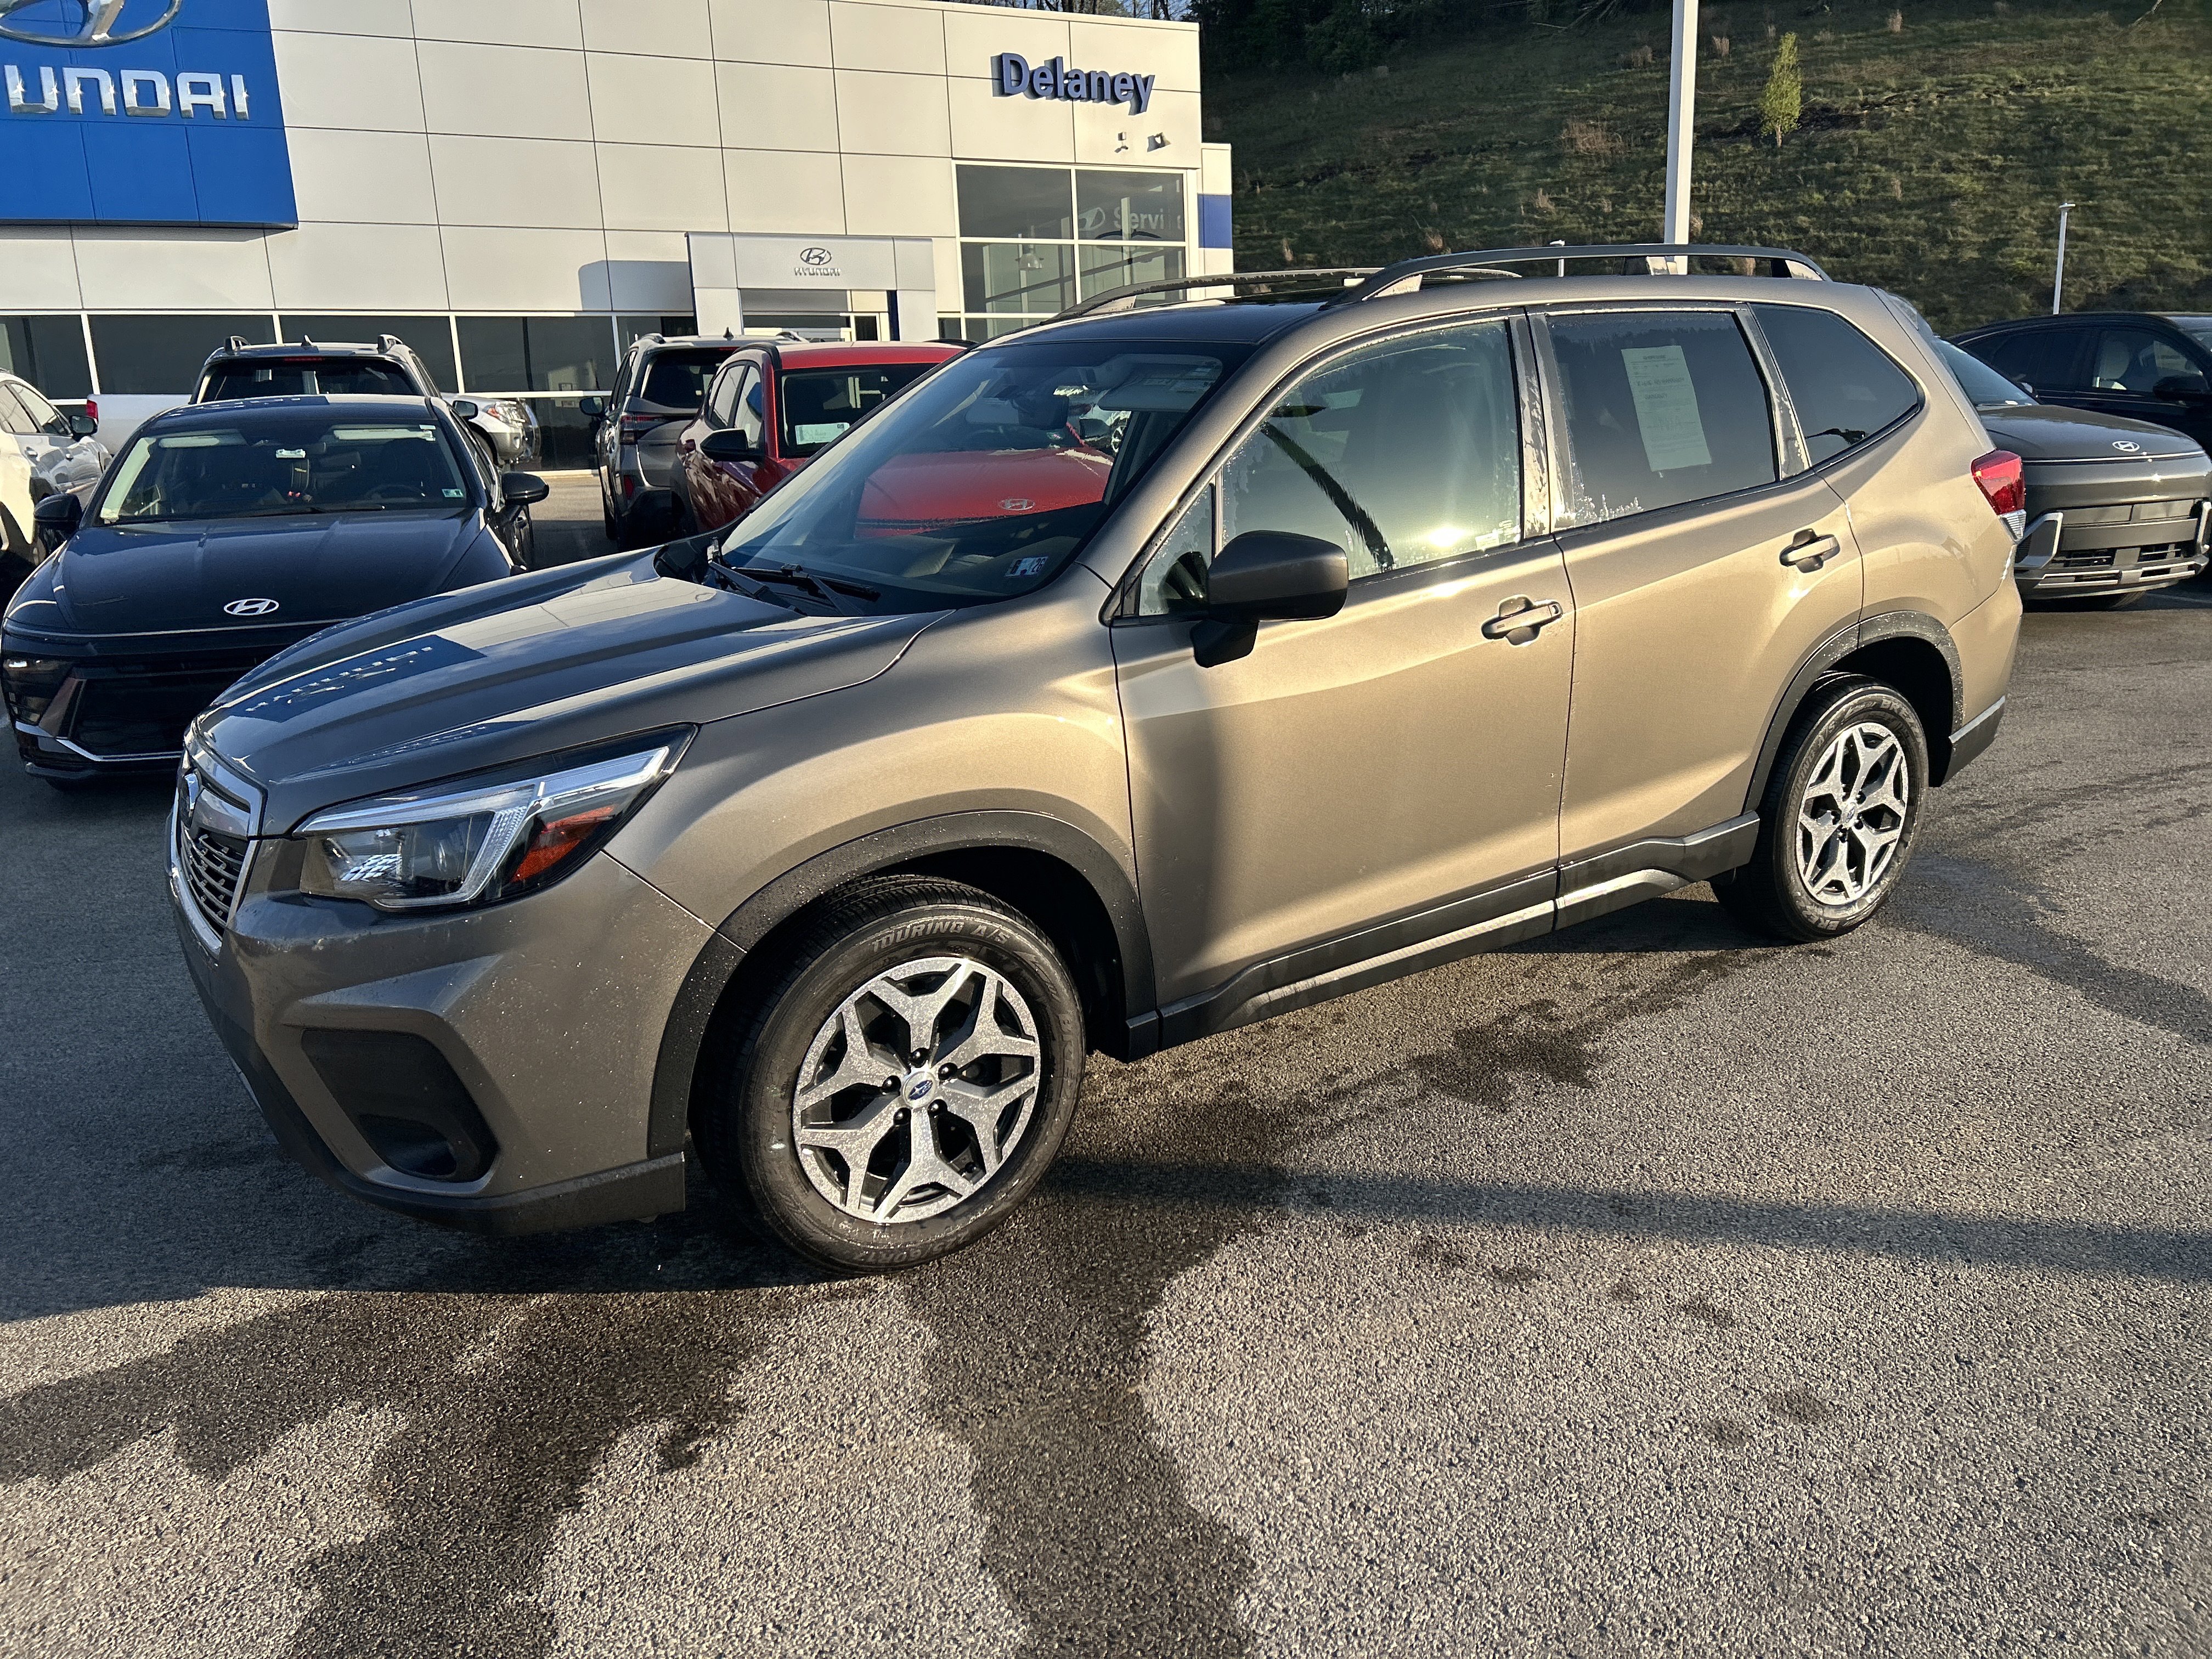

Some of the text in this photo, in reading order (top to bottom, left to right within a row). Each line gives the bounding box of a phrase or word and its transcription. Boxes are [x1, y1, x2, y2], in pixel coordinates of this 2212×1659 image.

[1000, 52, 1155, 114] Delaney
[794, 267, 841, 276] HYUNDAI
[871, 921, 1012, 953] TOURING A/S
